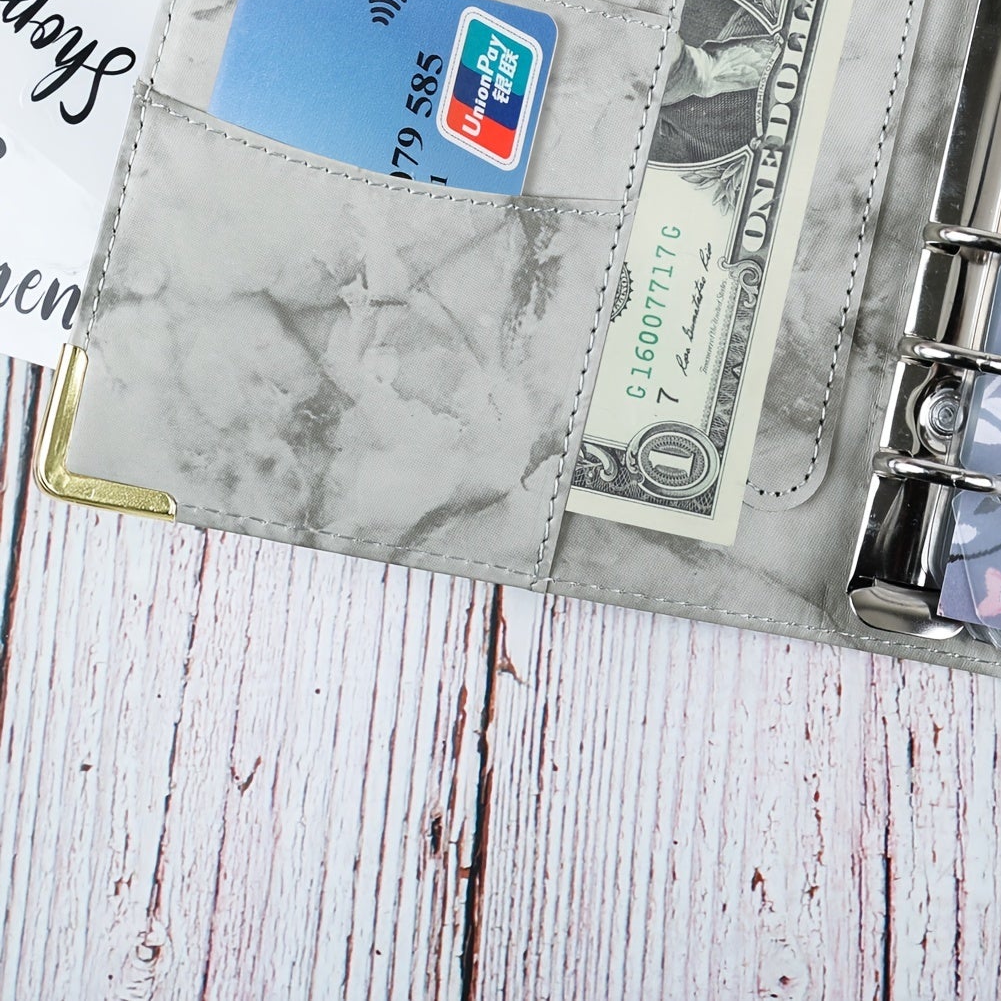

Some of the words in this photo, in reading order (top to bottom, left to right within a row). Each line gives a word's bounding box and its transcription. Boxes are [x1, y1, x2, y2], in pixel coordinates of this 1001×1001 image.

[406, 51, 444, 118] 585
[462, 34, 505, 137] UnionPay
[492, 49, 519, 104] 银联
[756, 57, 775, 125] WASHINGTON
[742, 149, 783, 252] ONE
[656, 387, 679, 404] 7
